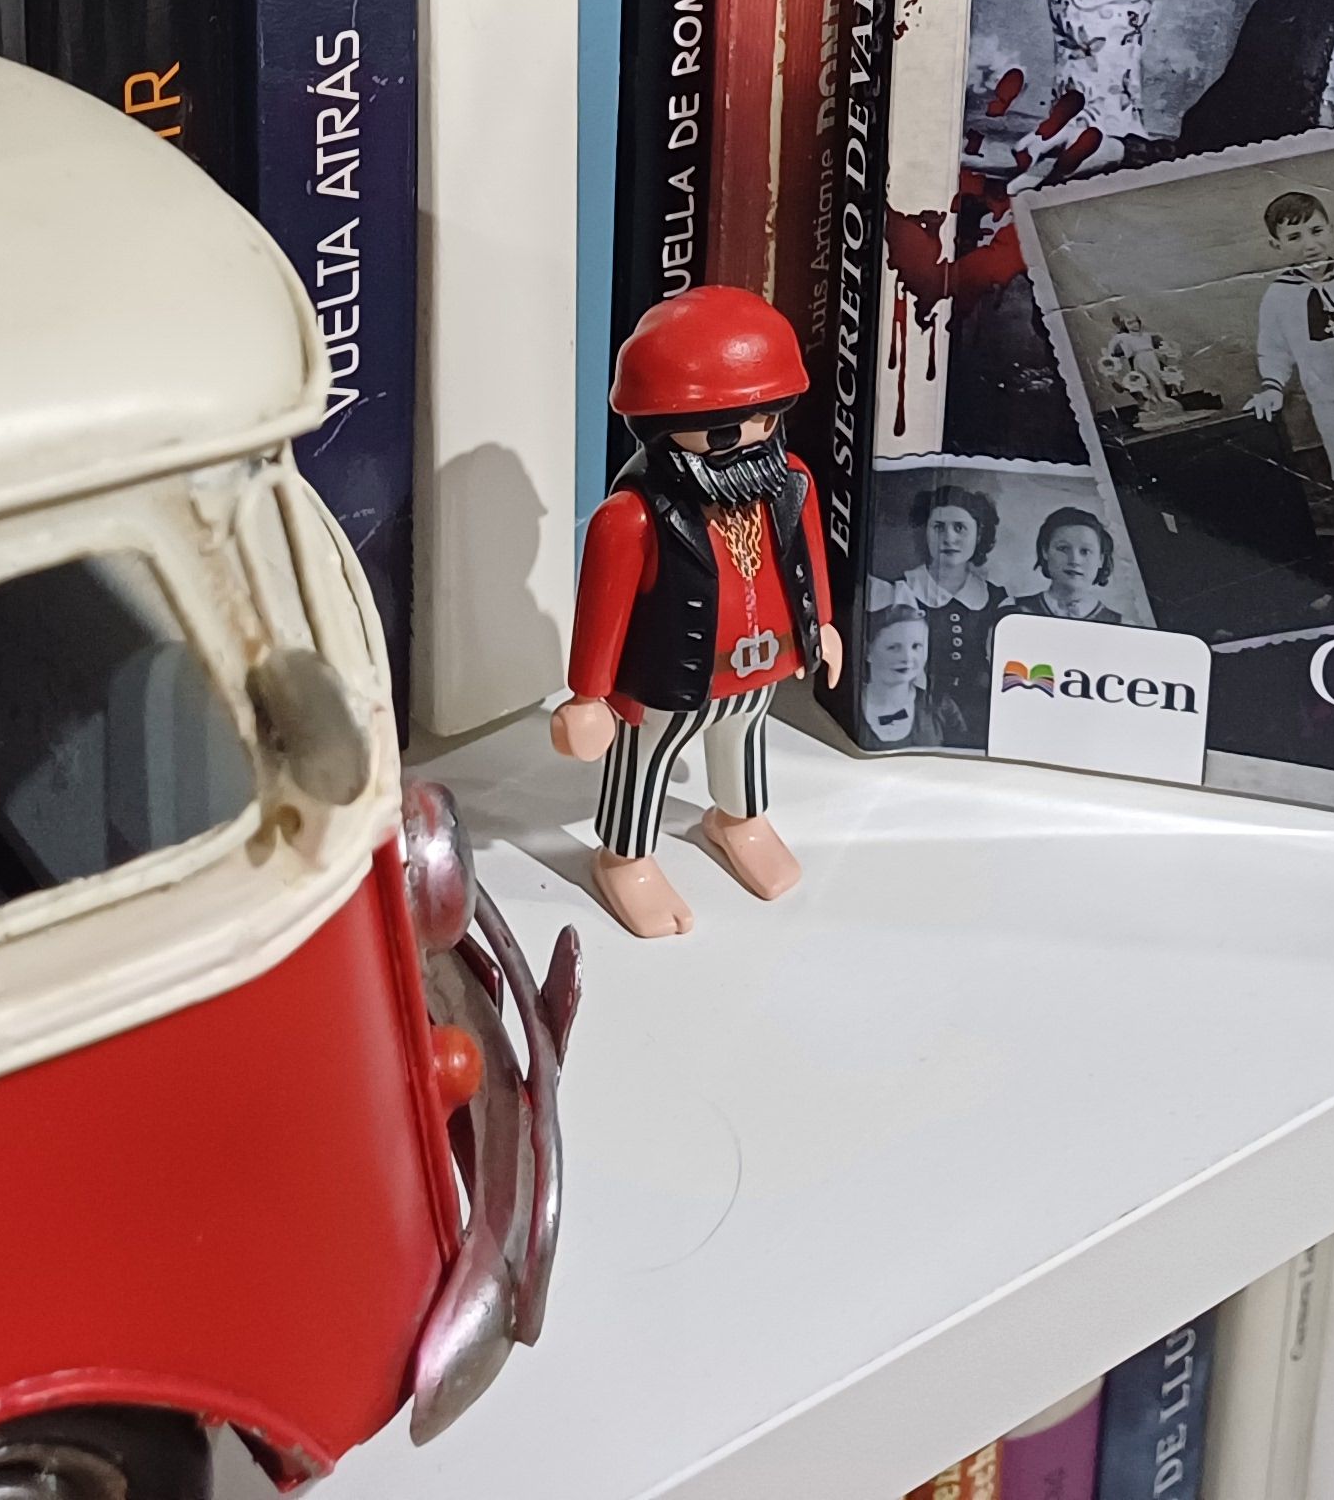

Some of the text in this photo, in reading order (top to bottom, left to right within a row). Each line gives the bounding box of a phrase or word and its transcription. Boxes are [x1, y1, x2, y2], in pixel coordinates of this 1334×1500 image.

[669, 92, 701, 152] DE
[846, 98, 868, 191] DE
[307, 28, 360, 420] VUELTA ATRÁS
[831, 202, 864, 466] SECRETO
[829, 466, 857, 558] EL
[1059, 664, 1199, 714] acen
[1153, 1422, 1188, 1500] DE
